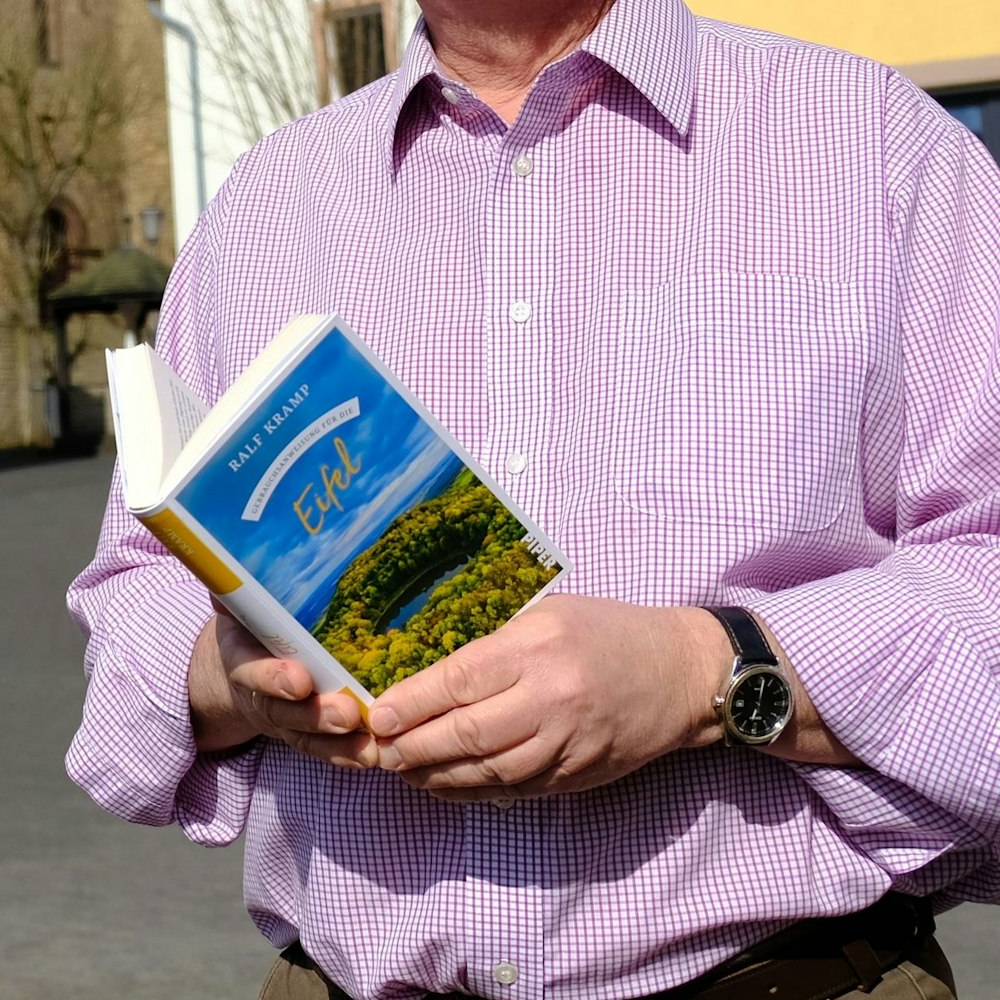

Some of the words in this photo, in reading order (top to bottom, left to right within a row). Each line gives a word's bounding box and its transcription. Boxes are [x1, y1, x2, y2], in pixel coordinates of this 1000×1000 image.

[227, 433, 263, 472] RALF
[263, 384, 310, 434] KRAMP
[251, 428, 320, 514] GEBRAUCHSANWEISUNG
[322, 416, 337, 429] FÜR
[339, 408, 354, 418] DIE
[293, 437, 362, 536] Eifel
[520, 532, 556, 571] PIPER
